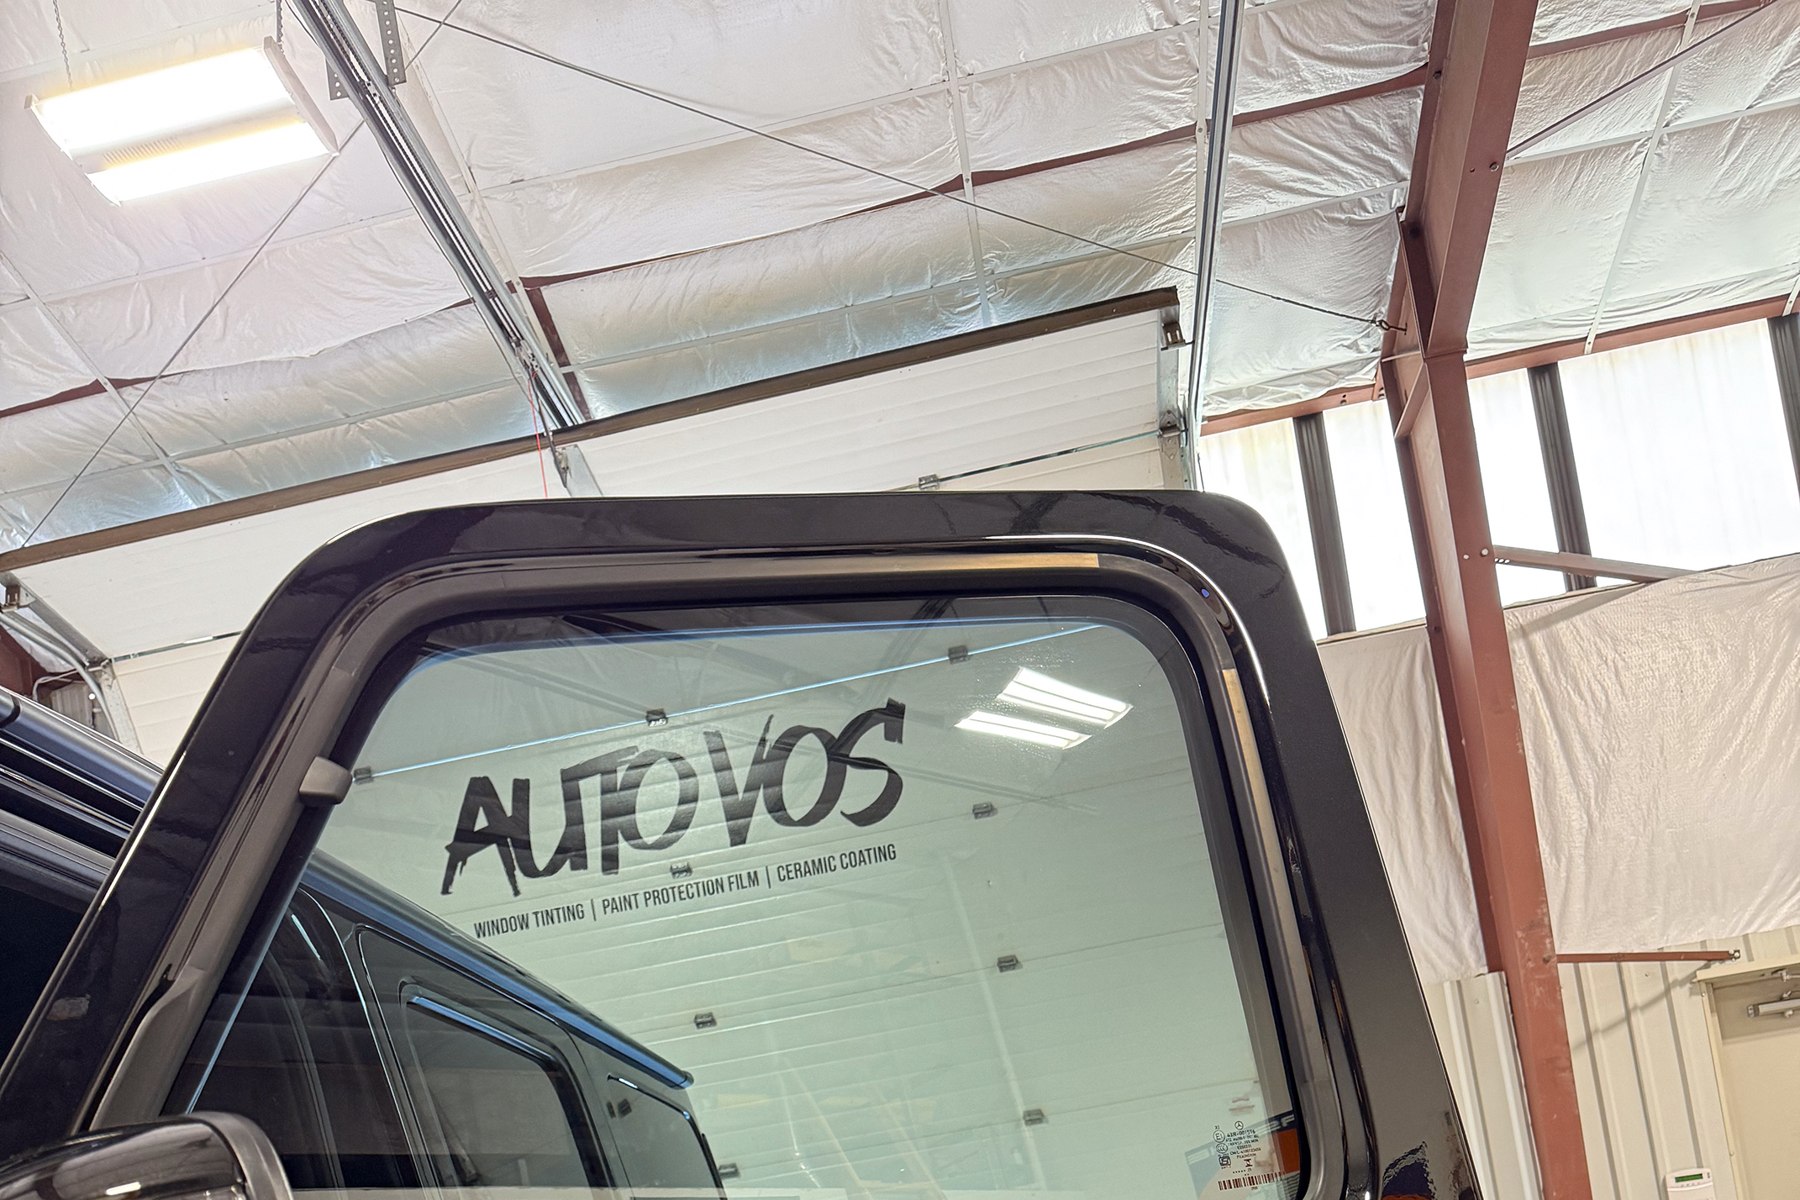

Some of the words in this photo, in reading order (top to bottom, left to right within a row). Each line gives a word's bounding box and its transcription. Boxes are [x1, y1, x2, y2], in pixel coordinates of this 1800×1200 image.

[441, 698, 906, 897] AUTOVOS
[474, 913, 530, 939] WINDOW
[532, 903, 585, 928] TINTING
[602, 892, 640, 916] PAINT
[643, 877, 725, 907] PROTECTION
[727, 870, 760, 892] FILM
[776, 855, 837, 882] CERAMIC
[840, 843, 897, 870] COATING
